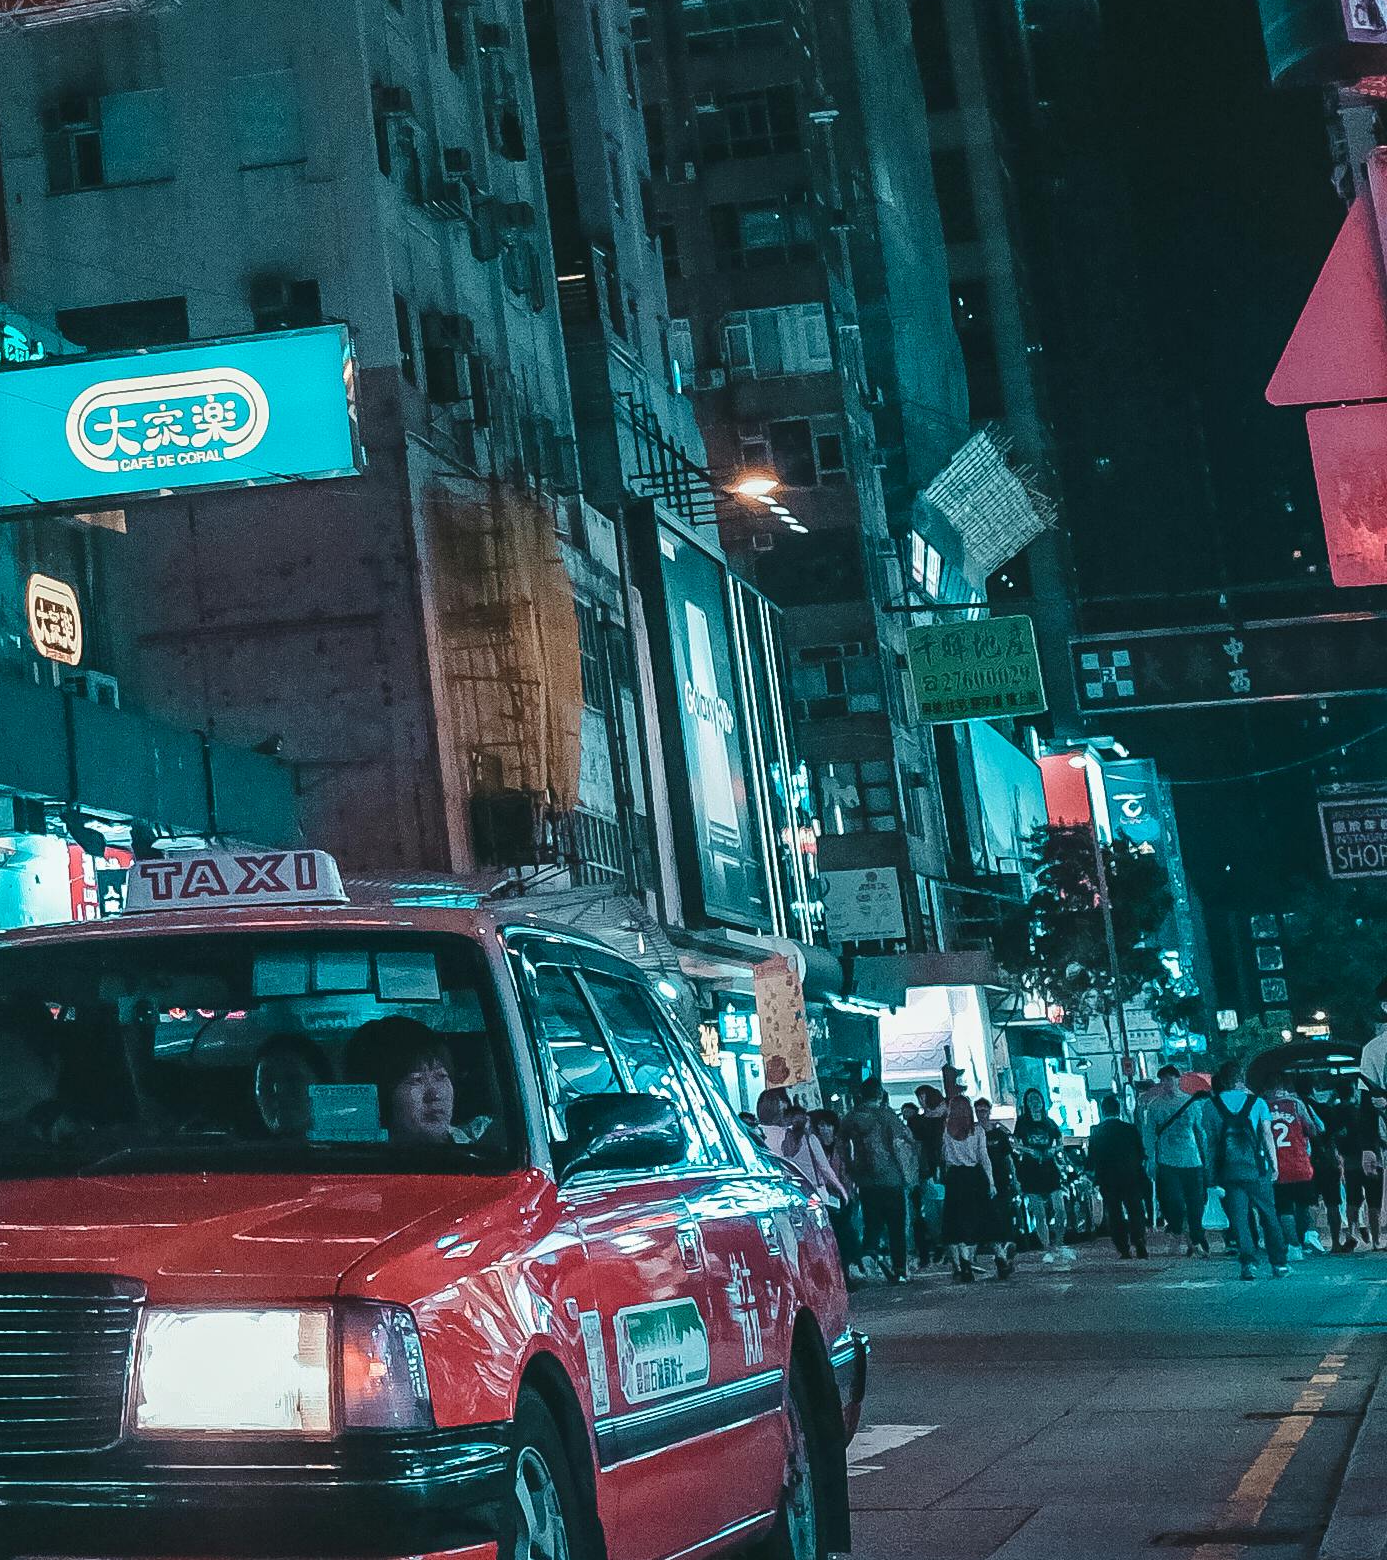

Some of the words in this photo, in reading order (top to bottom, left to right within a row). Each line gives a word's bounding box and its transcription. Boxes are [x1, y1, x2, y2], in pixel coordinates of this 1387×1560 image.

[120, 454, 154, 472] CAFÉ
[156, 453, 176, 468] DE
[177, 449, 224, 466] CORAL
[140, 851, 318, 901] TAXI
